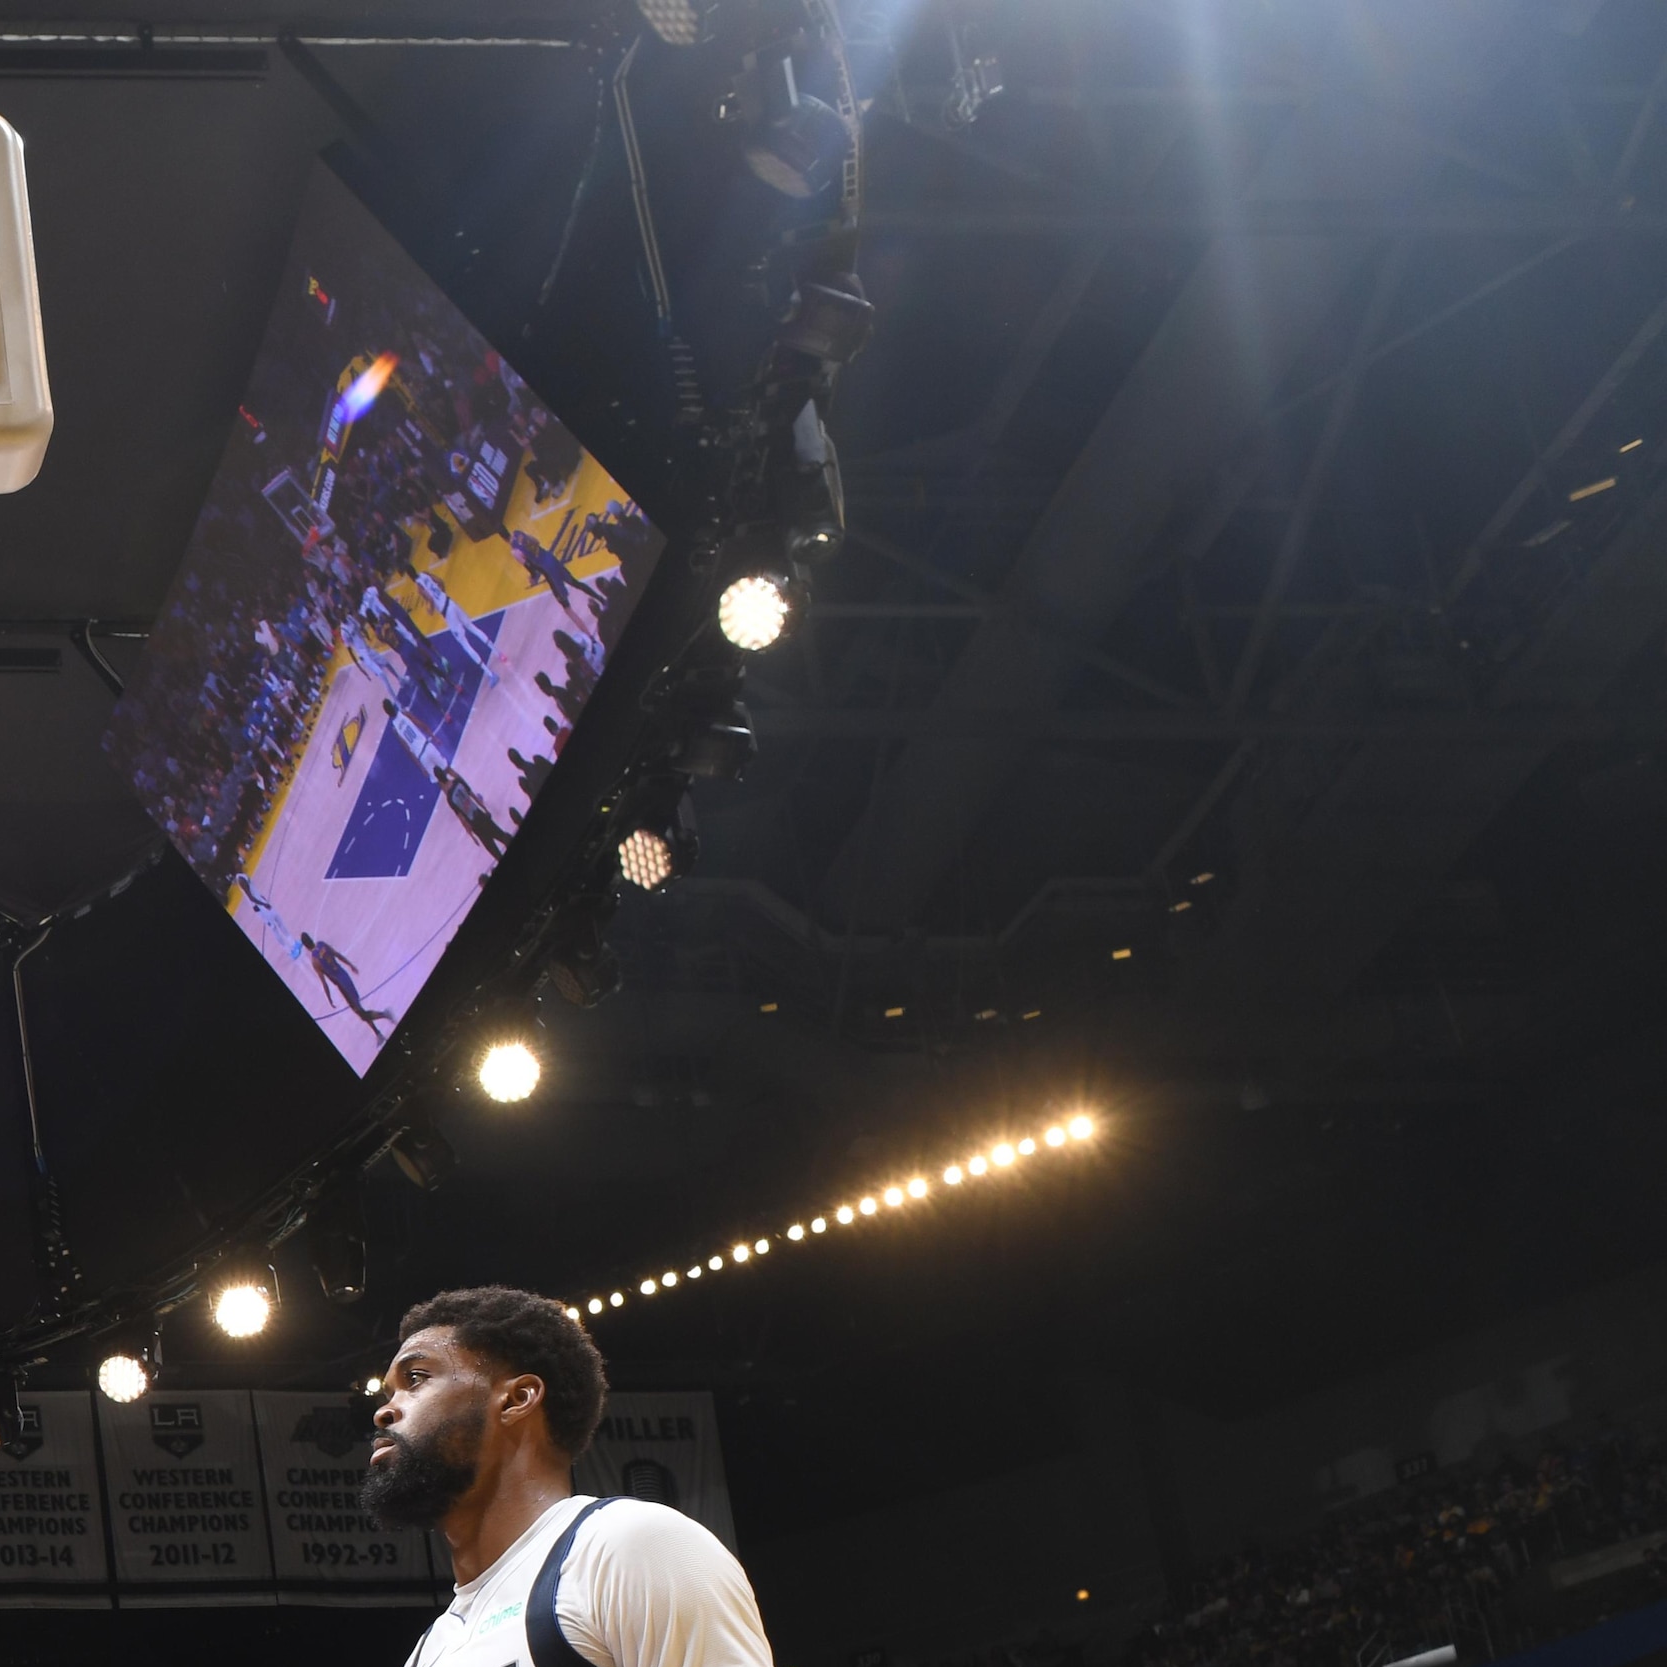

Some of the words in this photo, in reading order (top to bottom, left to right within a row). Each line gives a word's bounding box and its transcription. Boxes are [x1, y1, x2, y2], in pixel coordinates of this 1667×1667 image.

[133, 1468, 234, 1487] WESTERN
[119, 1490, 254, 1511] CONFERENCE
[128, 1514, 250, 1534] CHAMPIONS
[149, 1542, 237, 1566] 2011-12
[302, 1542, 399, 1566] 1992-93
[478, 1601, 523, 1635] chime
